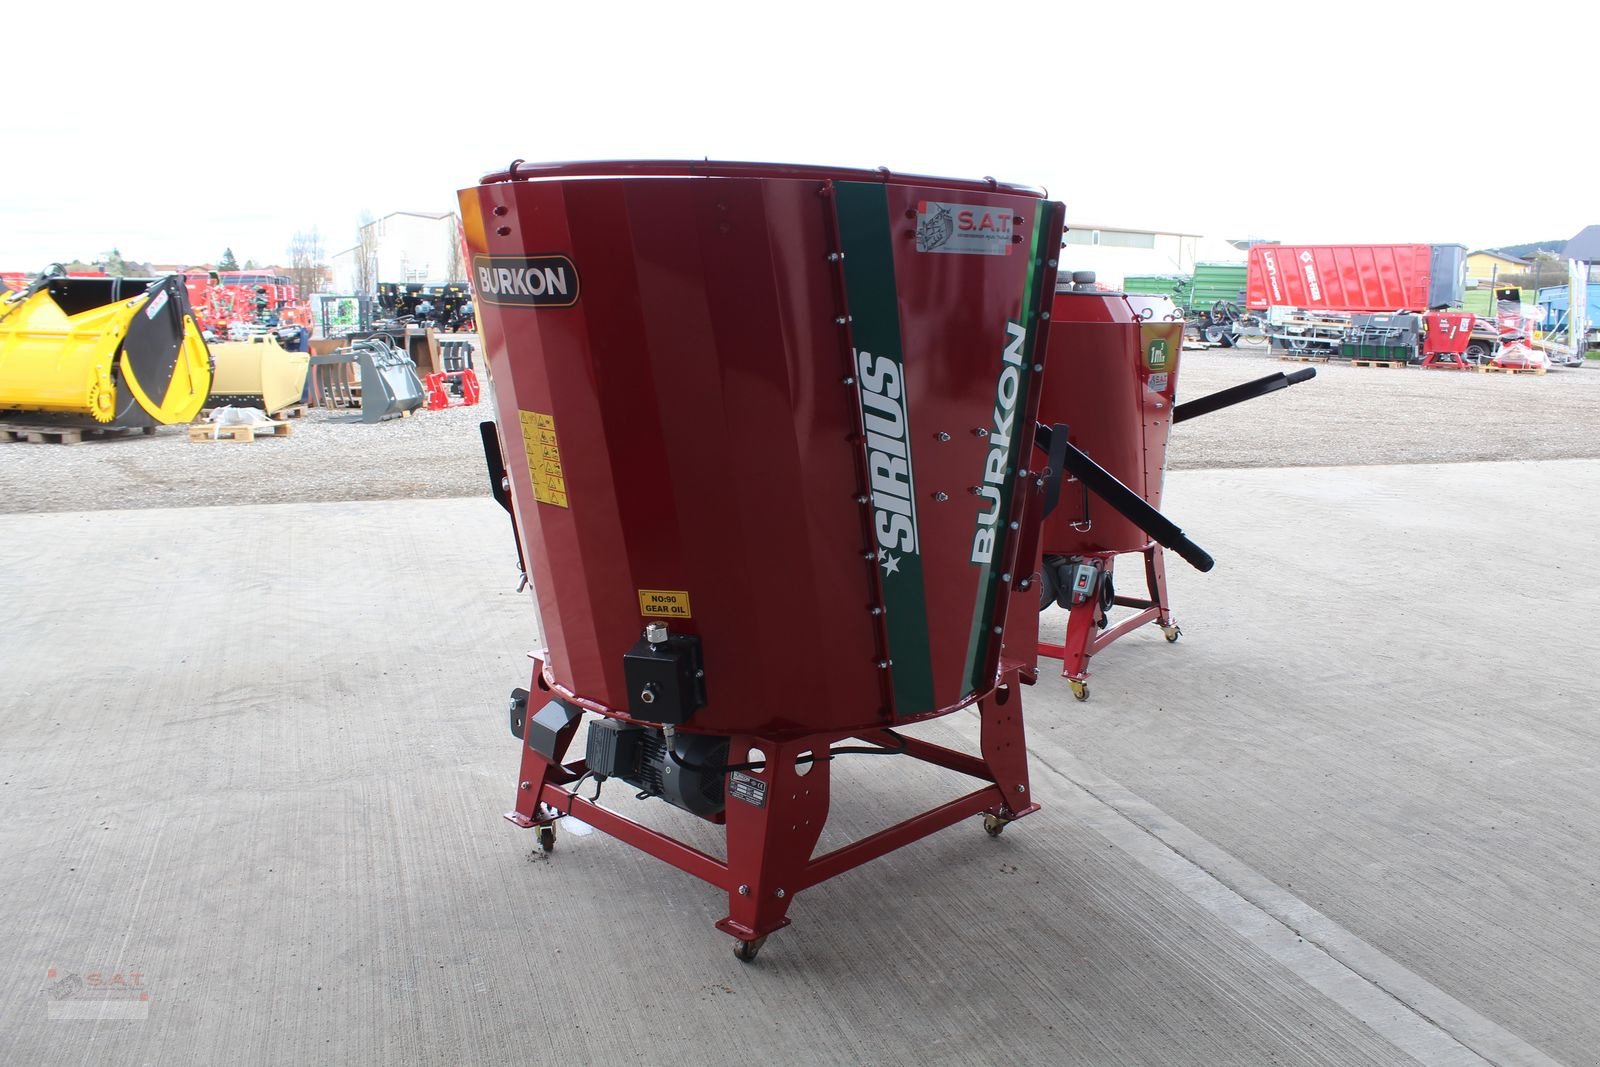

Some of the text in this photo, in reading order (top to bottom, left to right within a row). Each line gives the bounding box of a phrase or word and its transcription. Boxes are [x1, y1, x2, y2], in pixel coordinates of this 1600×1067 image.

[958, 210, 1010, 233] S.A.T.
[478, 267, 568, 295] BURKON
[859, 351, 913, 555] SIRIUS
[971, 321, 1026, 564] BURKON
[651, 595, 676, 603] NO:90
